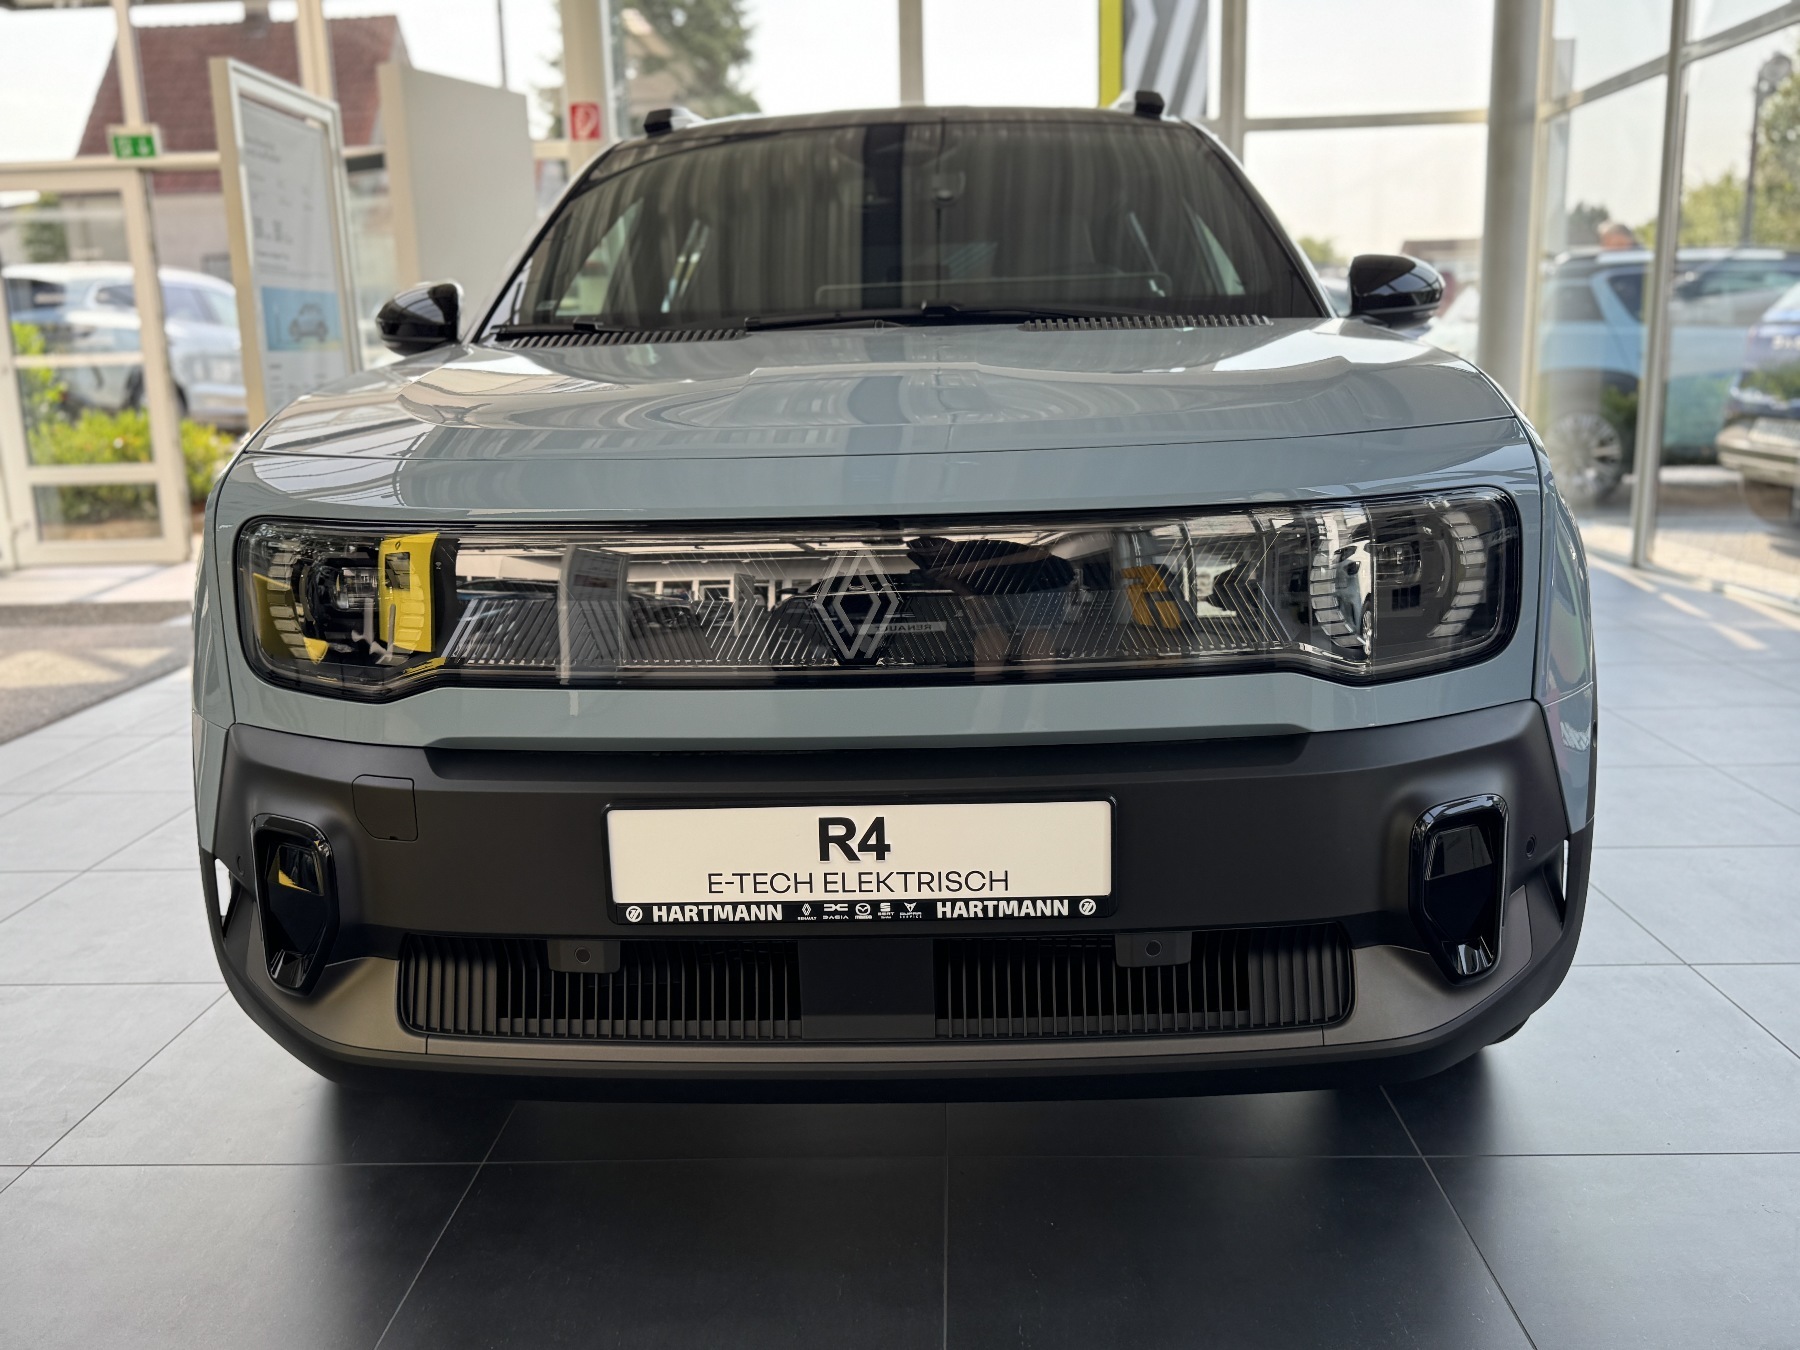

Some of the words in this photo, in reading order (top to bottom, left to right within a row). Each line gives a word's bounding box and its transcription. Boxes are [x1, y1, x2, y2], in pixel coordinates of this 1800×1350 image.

[818, 816, 891, 862] R4
[708, 872, 813, 894] E-TECH
[823, 870, 1009, 893] ELEKTRISCH
[652, 904, 782, 922] HARTMANN
[936, 899, 1068, 918] HARTMANN
